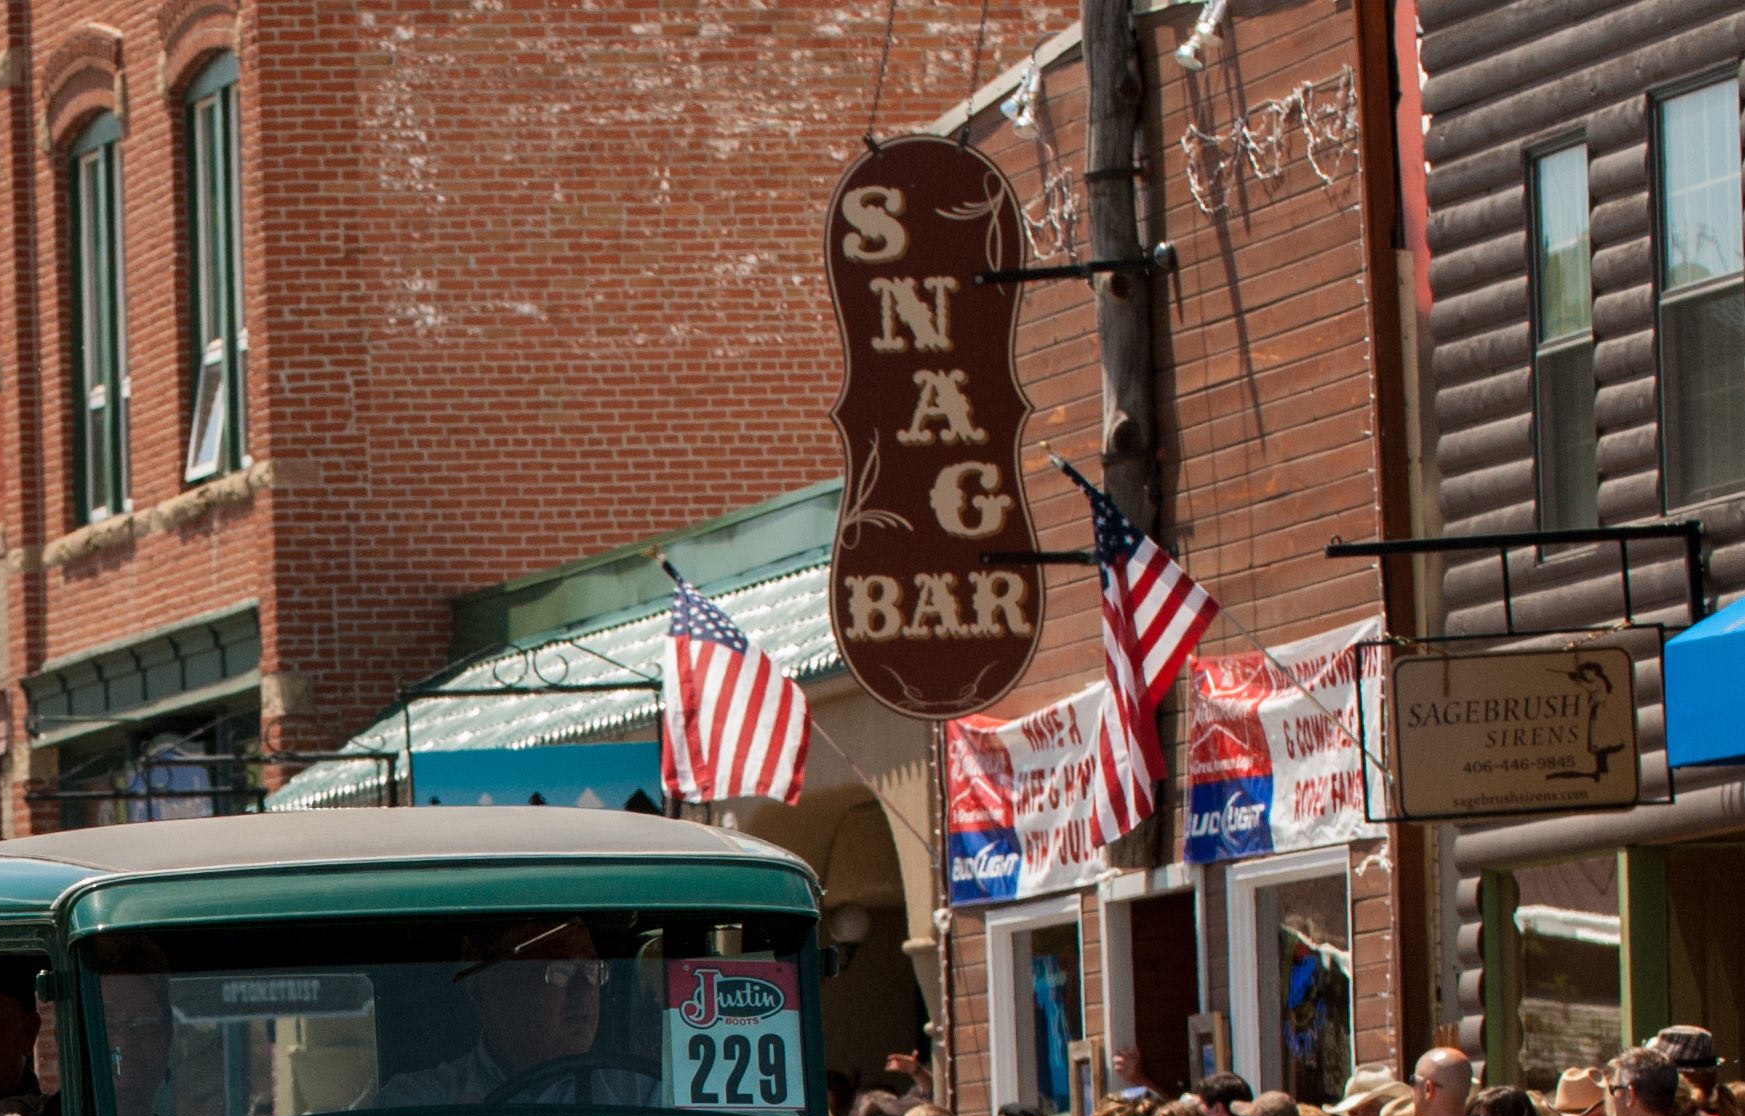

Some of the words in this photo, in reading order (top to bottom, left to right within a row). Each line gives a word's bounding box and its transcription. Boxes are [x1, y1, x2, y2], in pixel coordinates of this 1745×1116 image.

[842, 185, 1012, 540] SNAG
[845, 570, 1034, 642] BAR
[1022, 707, 1065, 752] HAVE
[1067, 702, 1082, 746] A
[1408, 694, 1581, 729] SAGEBRUSH
[1485, 725, 1580, 749] SIRENS
[1462, 755, 1576, 774] 406-446-9845
[680, 968, 777, 1029] Justin
[725, 1016, 760, 1027] BOOTS
[688, 1033, 789, 1106] 229
